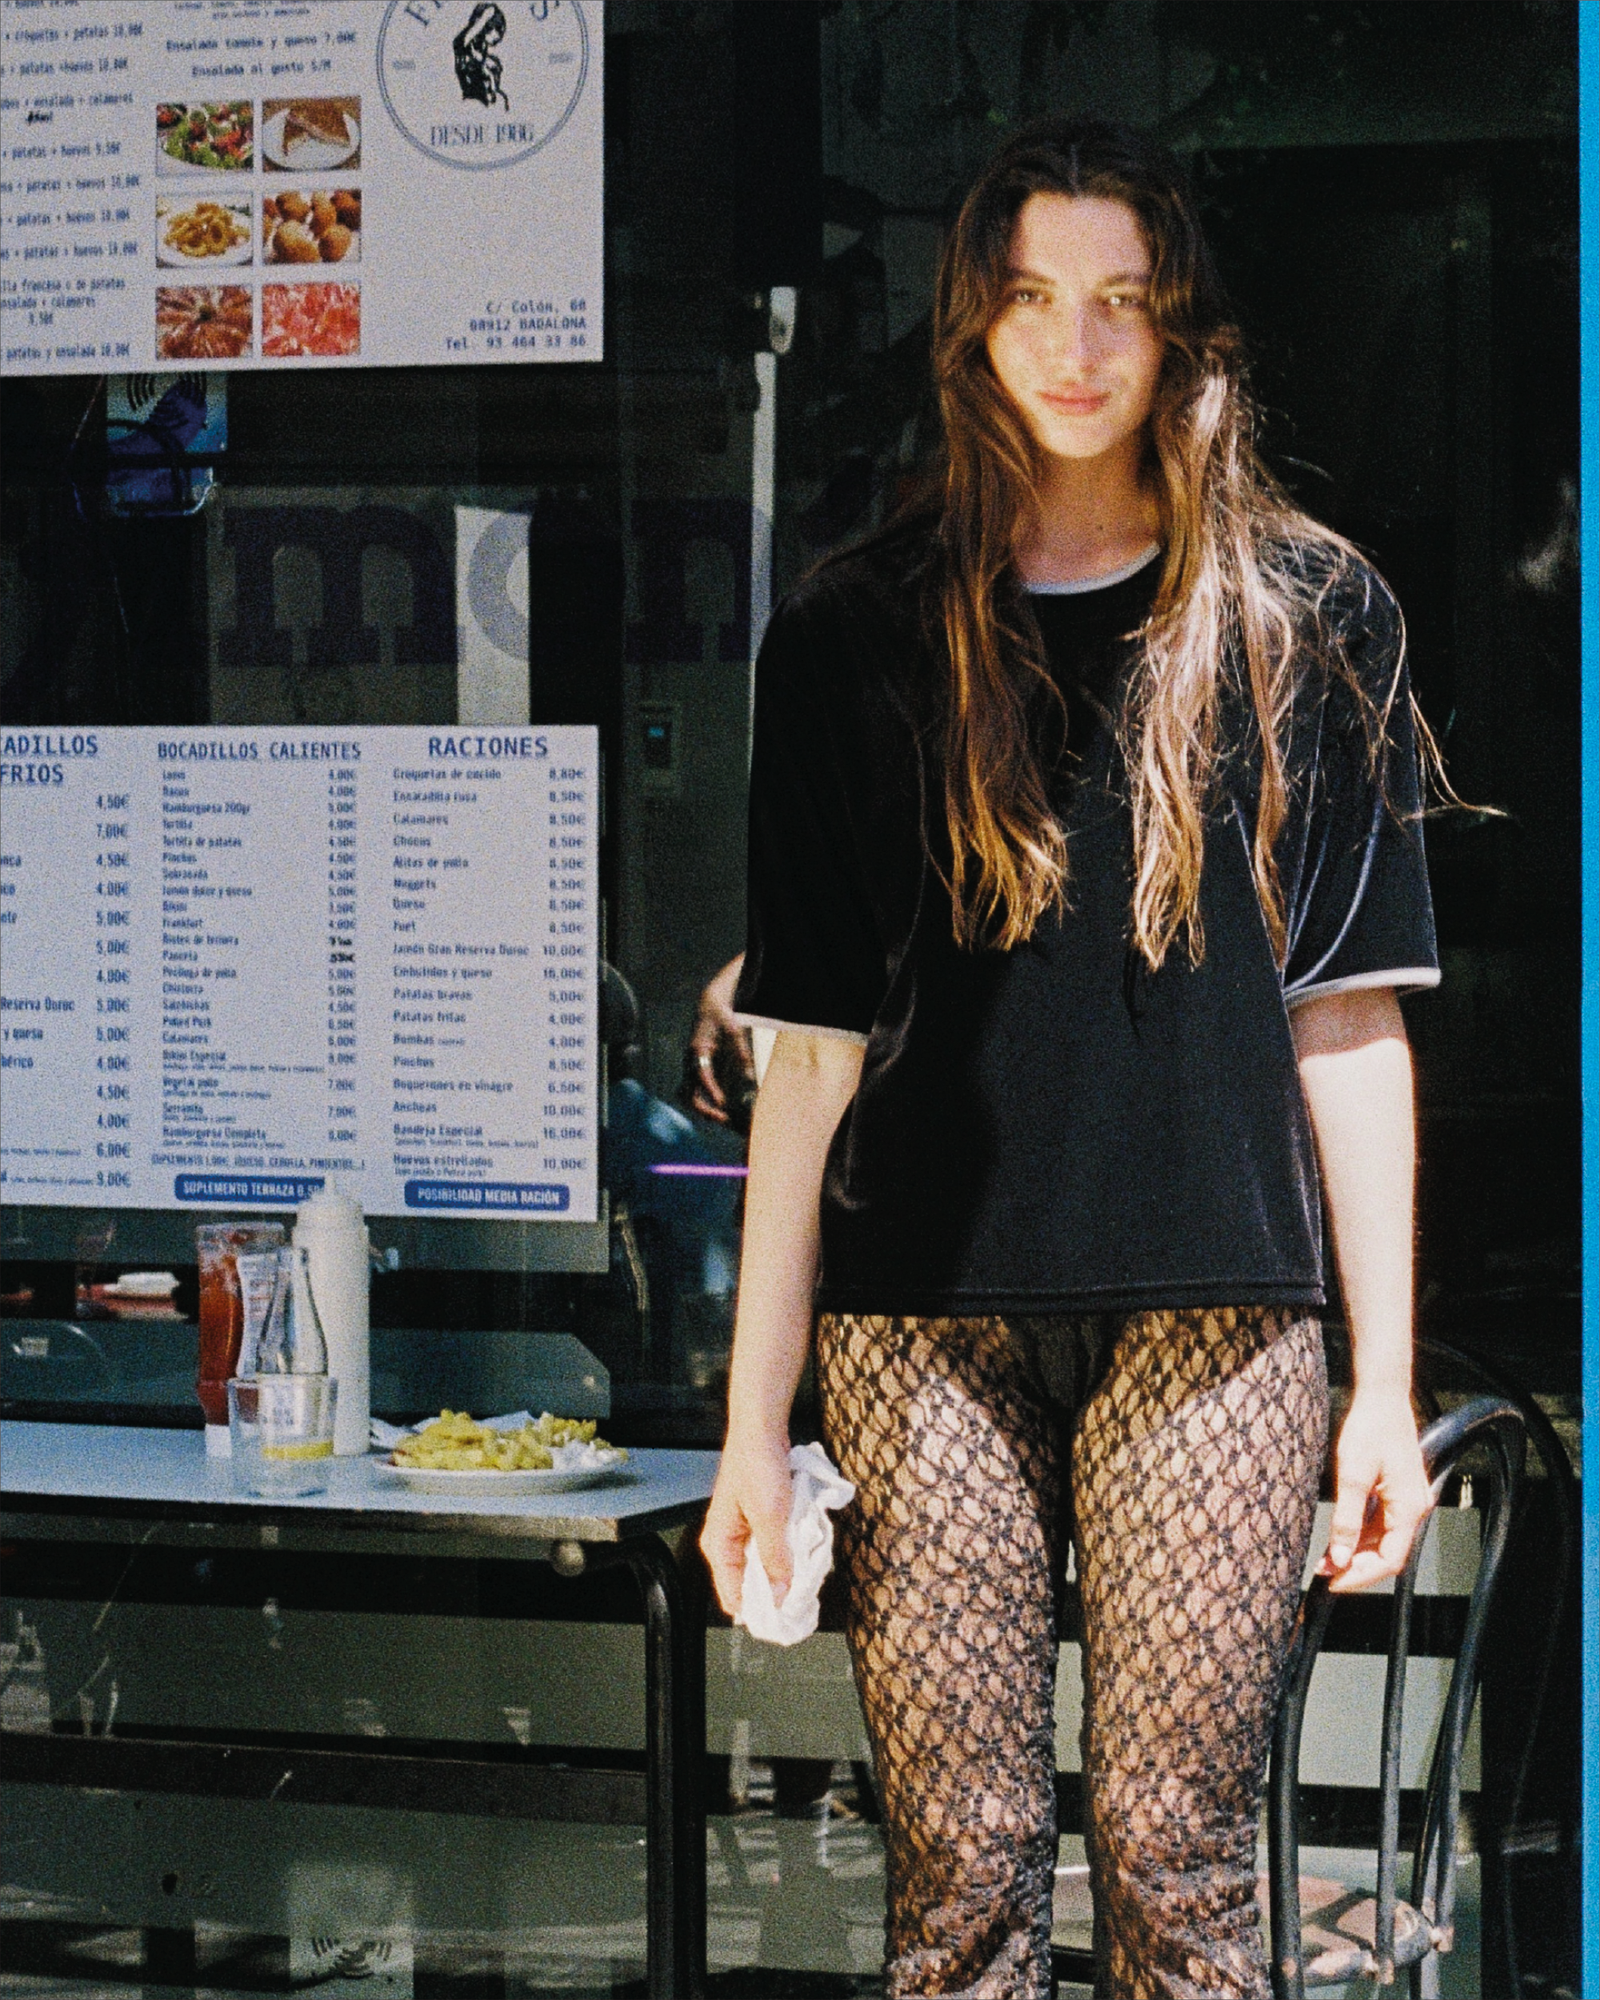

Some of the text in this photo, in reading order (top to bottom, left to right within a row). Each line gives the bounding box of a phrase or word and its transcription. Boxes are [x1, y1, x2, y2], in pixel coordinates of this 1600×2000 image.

[431, 125, 483, 145] DESDE
[520, 317, 586, 330] BADALONA
[0, 735, 98, 757] ADILLOS
[158, 742, 361, 760] BOCADILLOS CALIENTES
[429, 737, 548, 758] RACIONES
[0, 764, 63, 785] FRIOS
[451, 769, 462, 779] de
[196, 837, 205, 846] de
[427, 858, 438, 868] de
[202, 968, 212, 977] de
[183, 1181, 294, 1196] SUPLEMENTO TERRAZA
[418, 1188, 559, 1204] POSIBILIDAD MEDIA RACIÓN
